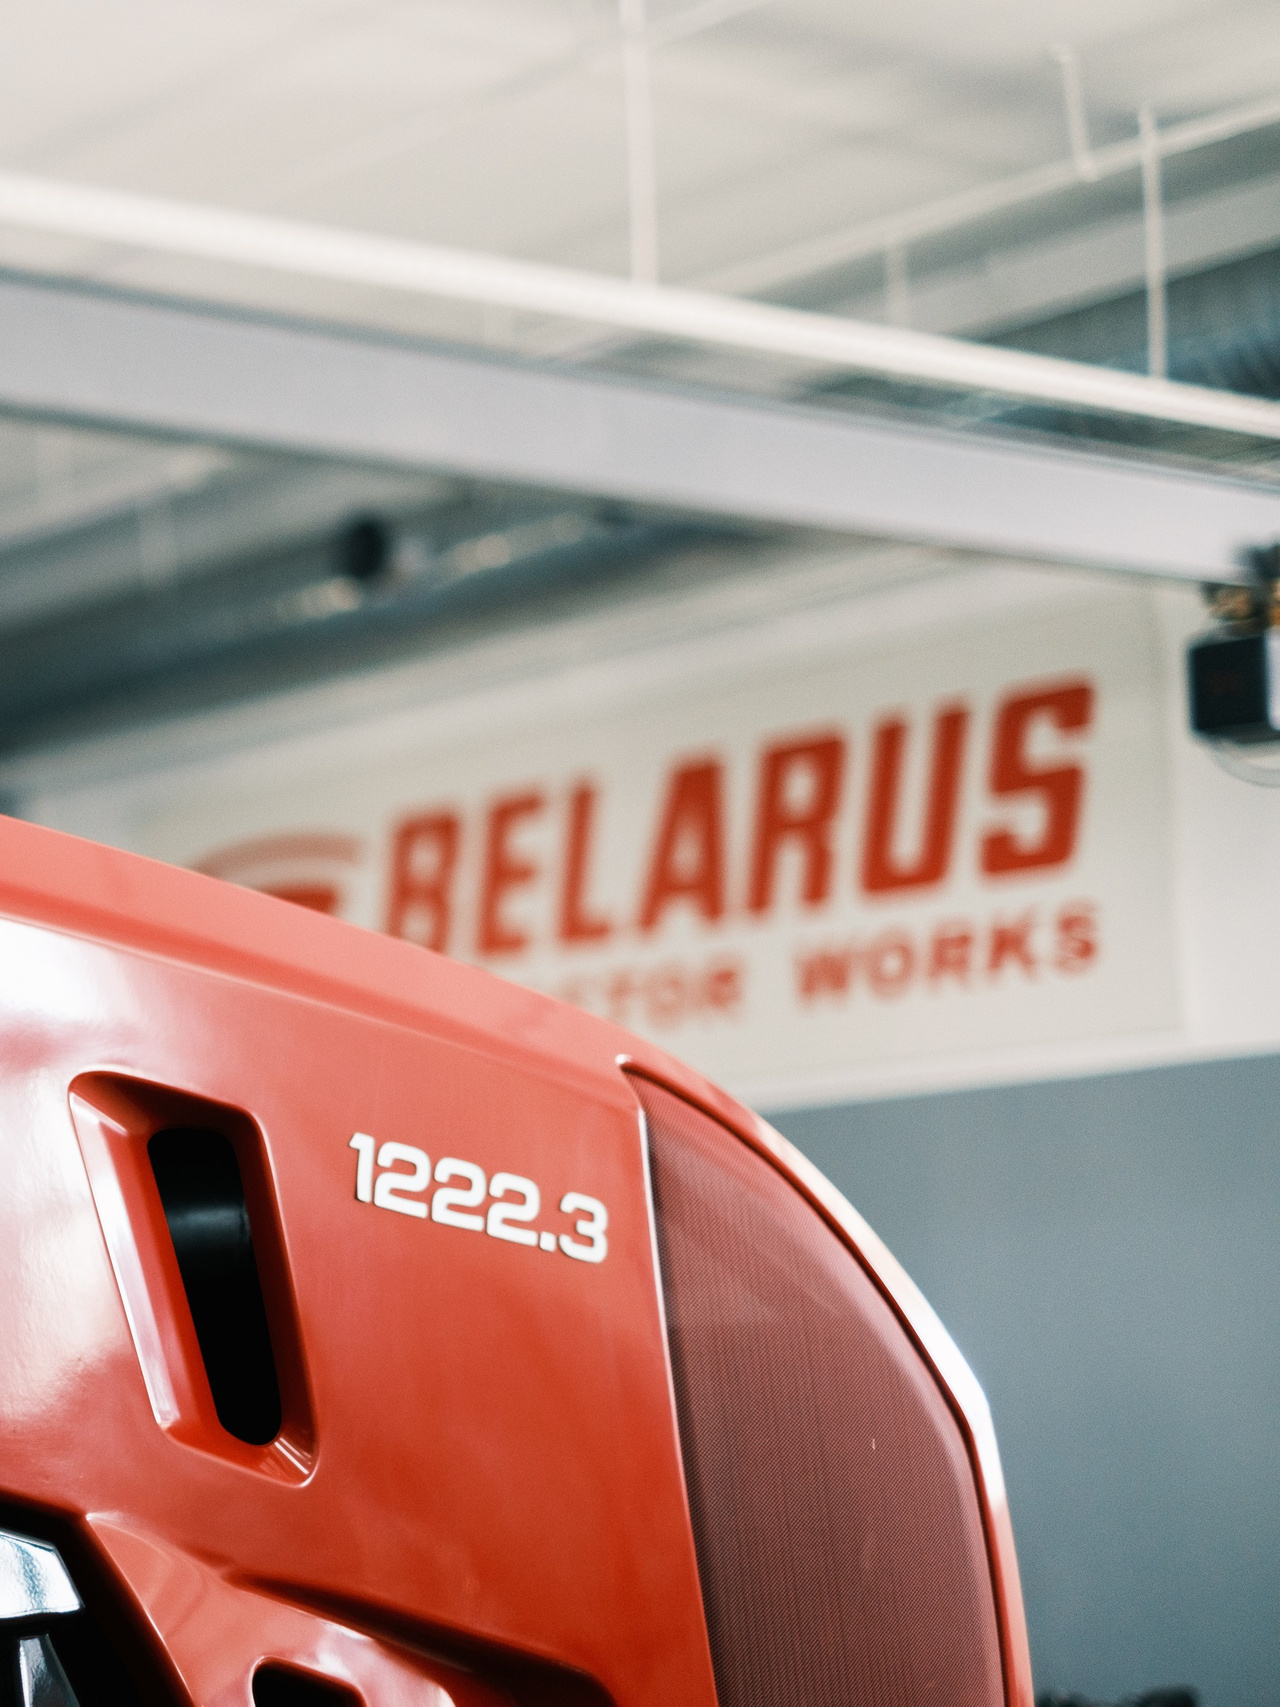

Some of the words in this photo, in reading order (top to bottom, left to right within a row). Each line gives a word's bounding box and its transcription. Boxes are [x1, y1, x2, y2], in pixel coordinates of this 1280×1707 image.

[386, 674, 1097, 958] BELARUS
[793, 904, 1098, 1004] WORKS
[349, 1132, 609, 1263] 1222.3
